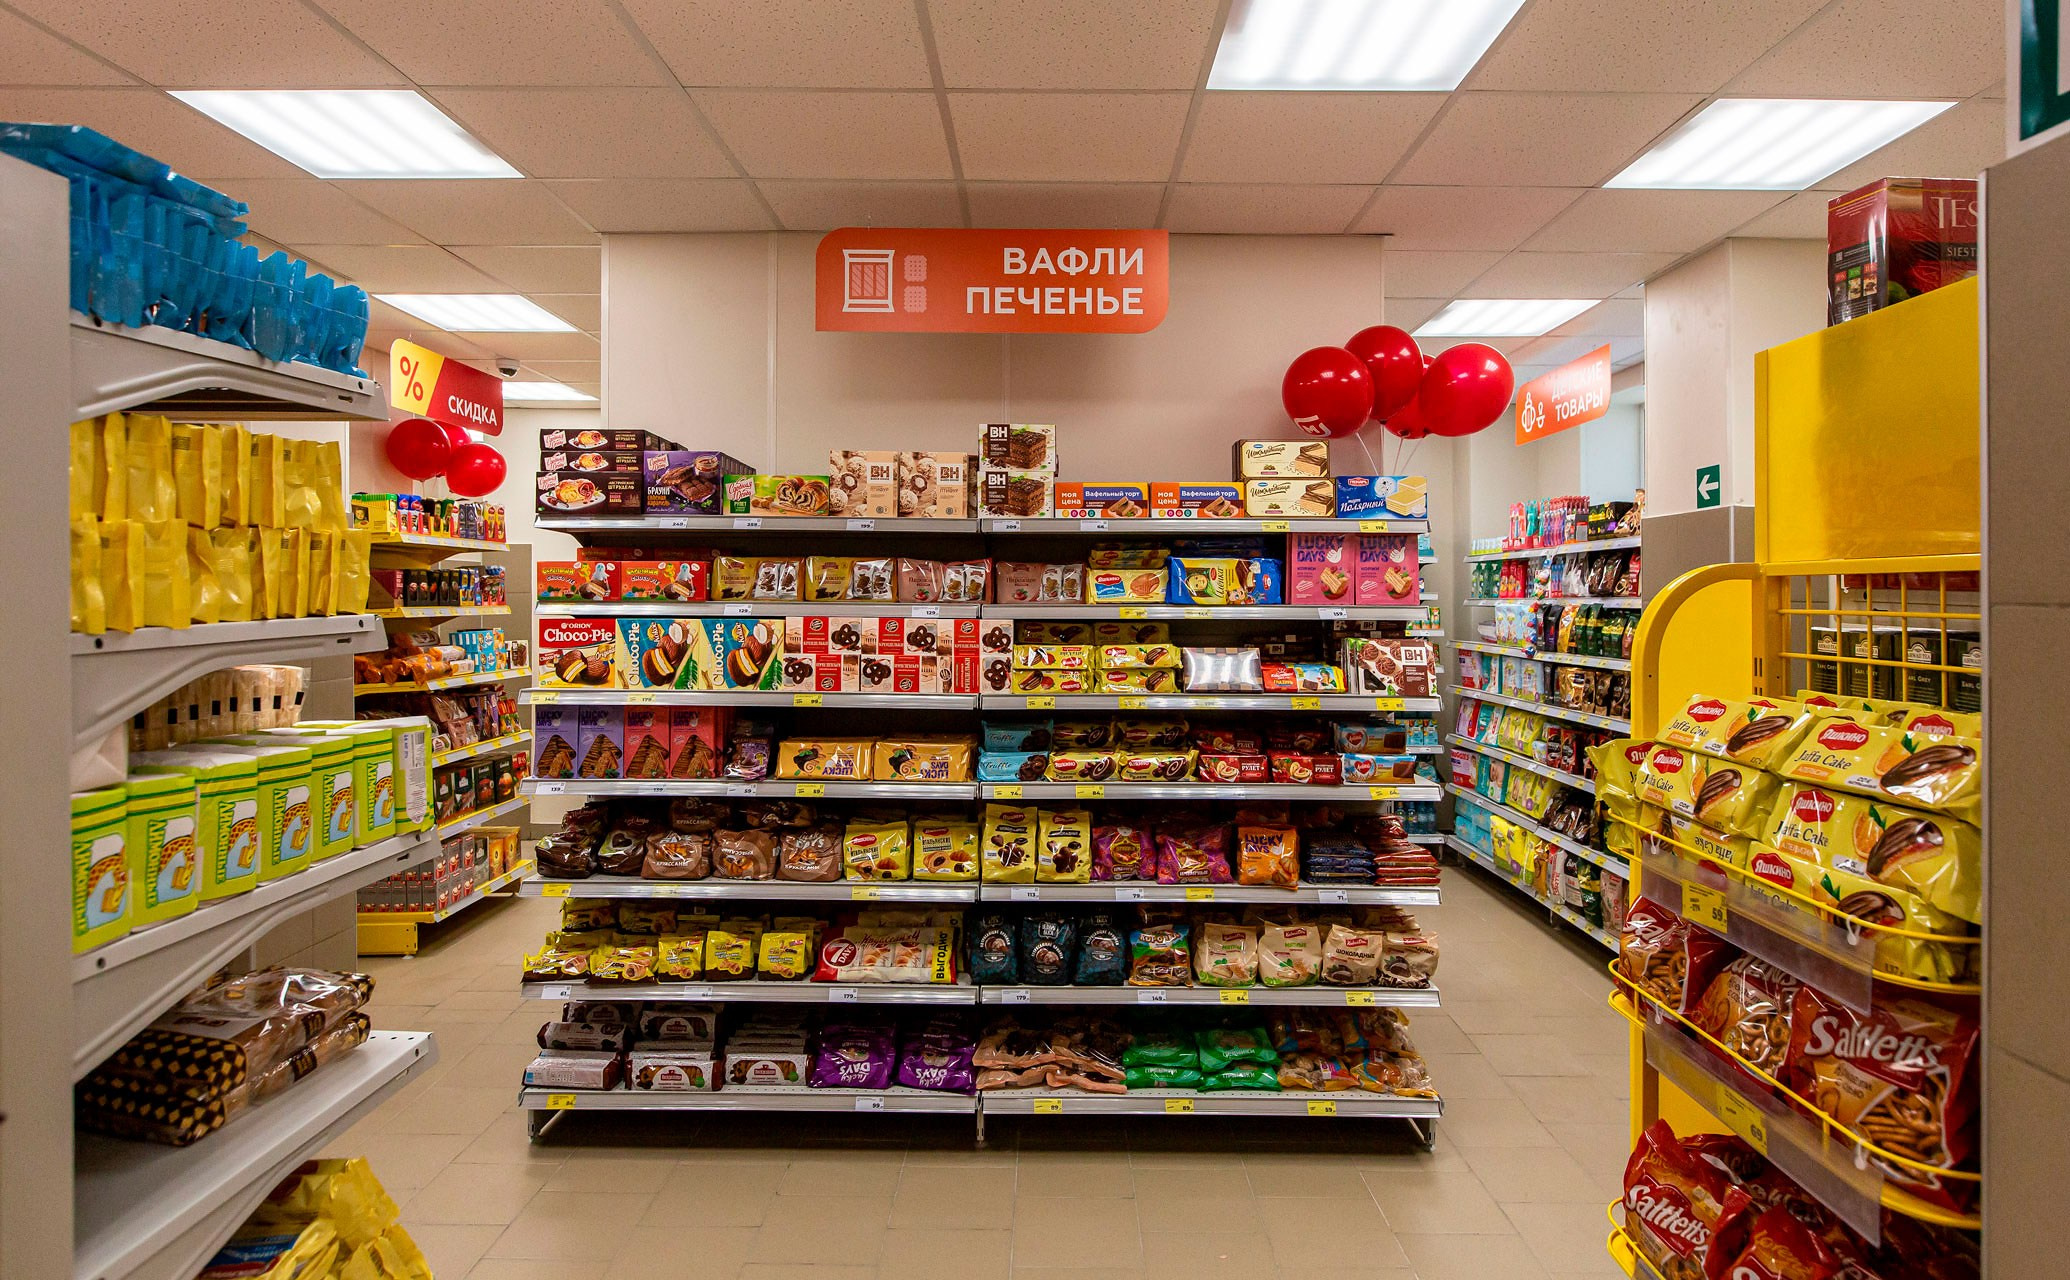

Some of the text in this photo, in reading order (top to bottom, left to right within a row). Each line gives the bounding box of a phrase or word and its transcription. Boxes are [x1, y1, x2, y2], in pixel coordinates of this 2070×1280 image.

[1003, 247, 1144, 275] ВАФЛИ
[966, 287, 1144, 315] ПЕЧЕНЬЕ
[1552, 360, 1603, 403] ДЕТСКИЕ
[448, 395, 497, 426] СКИДКА
[1555, 388, 1603, 421] ТОВАРЫ
[1085, 490, 1140, 498] Вафельный торт
[1221, 490, 1236, 498] торт
[1340, 500, 1384, 512] Полярный
[1298, 535, 1345, 549] LUCKY
[1298, 551, 1325, 562] DAYS
[1361, 551, 1388, 562] DAYS
[1404, 650, 1423, 660] BH
[1690, 705, 1724, 716] Яшкино
[1669, 720, 1688, 732] Jaffa
[1820, 729, 1865, 743] Яшкино
[1654, 754, 1682, 767] Яшкино
[1794, 750, 1852, 770] Jaffa Cake
[822, 766, 853, 776] LUCKY
[1656, 778, 1674, 792] Cake
[217, 801, 235, 884] ЛИМОННЫЕ
[1245, 834, 1284, 846] LUCKY
[1802, 827, 1829, 847] Cake
[1694, 836, 1714, 854] Cake
[1755, 860, 1792, 879] Яшкино
[1712, 907, 1723, 921] 59
[829, 942, 855, 963] 7 DAYS
[936, 932, 948, 979] ВЫГОДНО
[1336, 949, 1375, 958] ШОКОЛАДНЫЕ
[1804, 1016, 1943, 1067] Saltletts
[839, 1062, 870, 1075] DAYS
[915, 1068, 947, 1079] DAYS
[841, 1073, 869, 1083] Lucky
[919, 1076, 946, 1088] Lucky
[1751, 1125, 1763, 1142] 69
[1626, 1185, 1711, 1245] Saltletts
